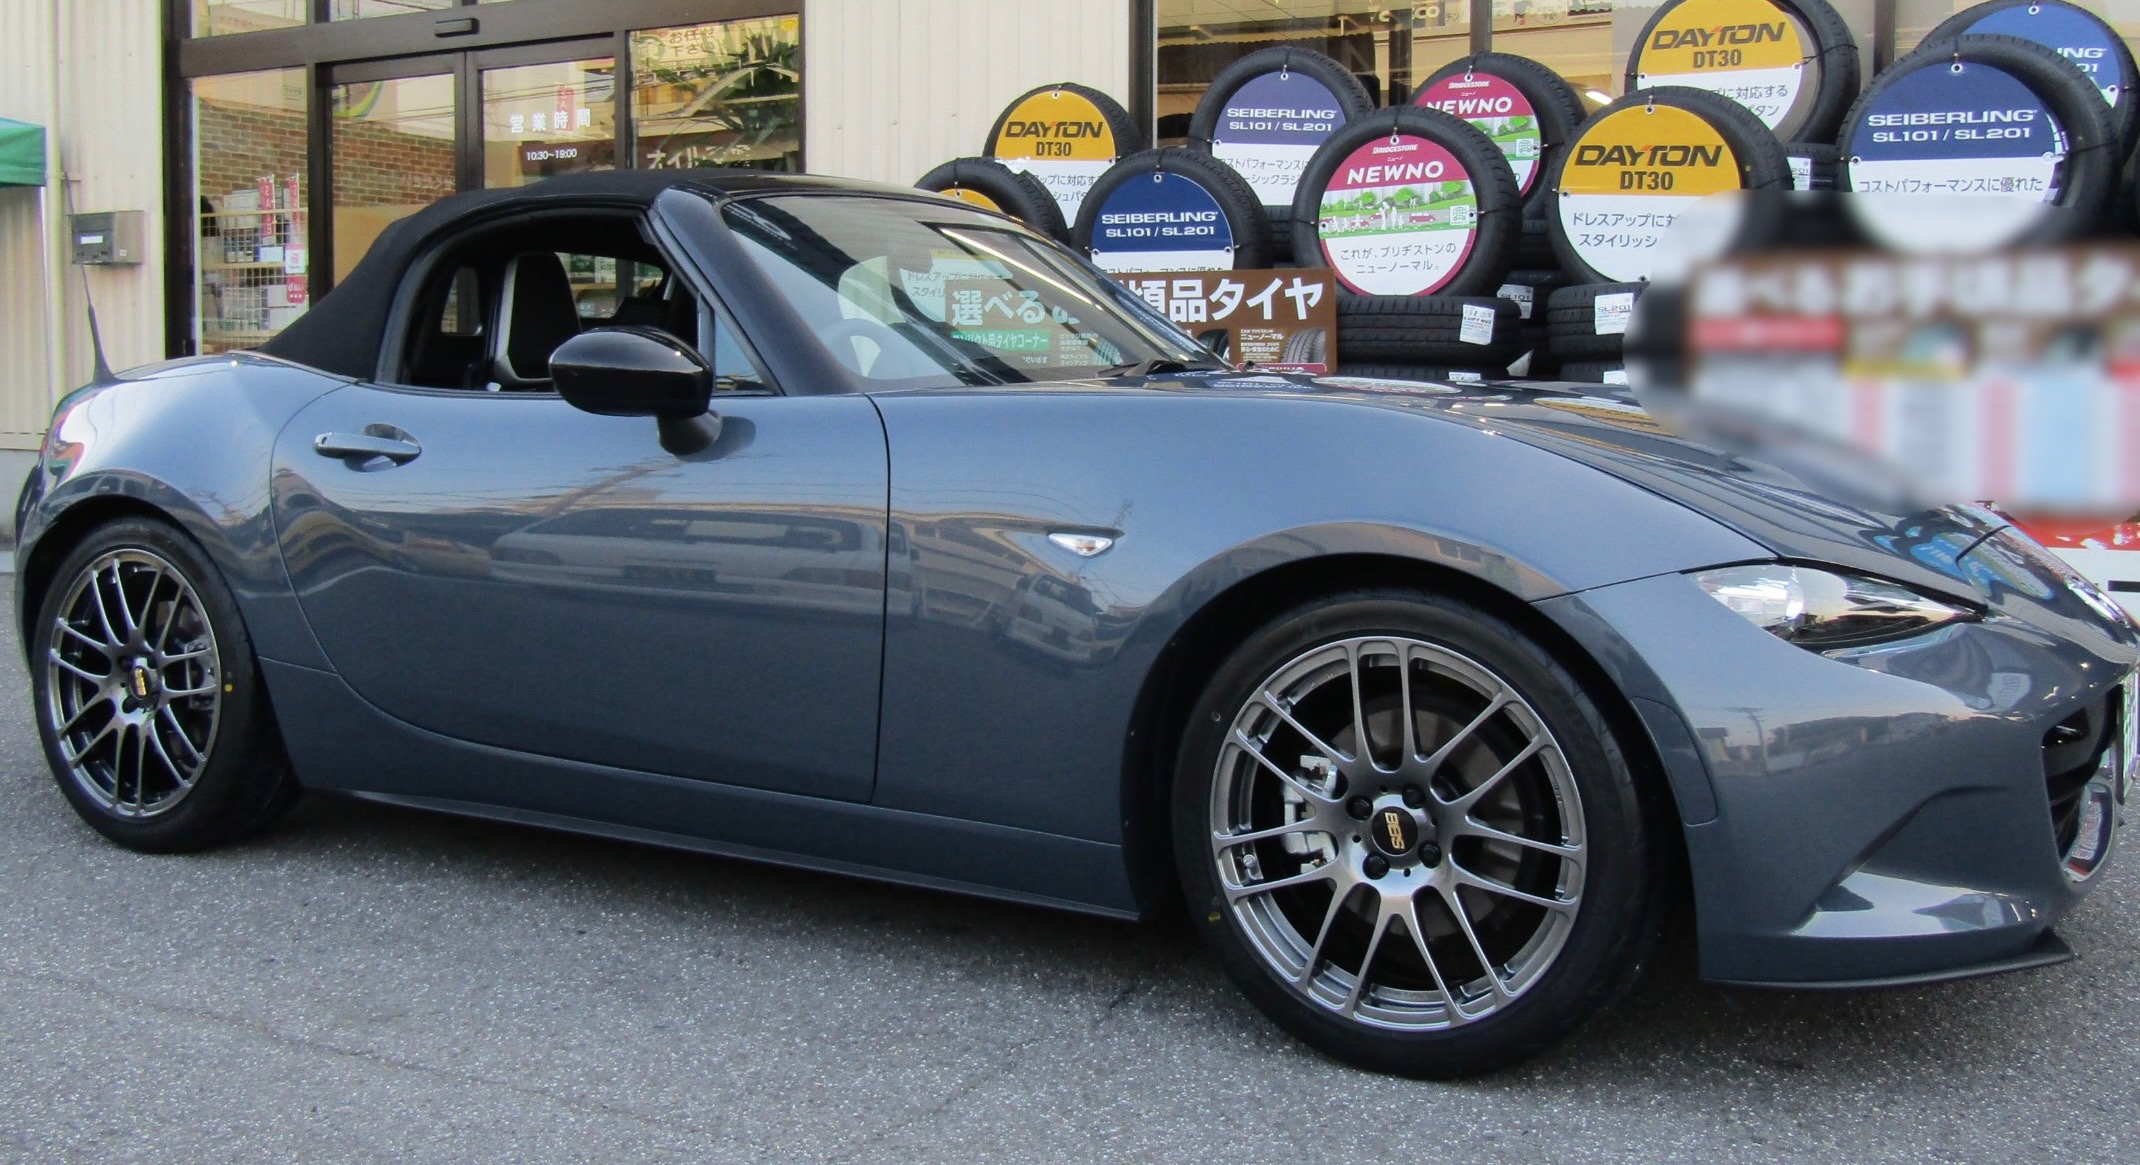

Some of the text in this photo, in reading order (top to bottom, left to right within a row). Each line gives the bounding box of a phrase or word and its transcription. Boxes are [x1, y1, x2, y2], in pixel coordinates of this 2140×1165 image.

[1651, 22, 1785, 50] DAYTON
[1693, 49, 1742, 69] DT30
[2056, 47, 2107, 59] ING
[1448, 80, 1490, 89] BRIDGESTONE
[1227, 108, 1337, 120] SEIBERLING
[1427, 96, 1513, 115] NEWNO
[510, 108, 591, 134] 営業時間
[1229, 121, 1272, 131] SL101
[1282, 123, 1332, 132] SL201
[1868, 109, 2038, 127] SEIBERLING
[1004, 121, 1104, 138] DAYTON
[1873, 130, 1938, 143] SL101
[1954, 128, 2031, 140] SL201
[1035, 141, 1072, 157] DT30
[1371, 144, 1419, 155] BRIDGESTONE
[1575, 145, 1724, 167] DAYTON
[1346, 161, 1445, 185] NEWNO
[1619, 171, 1674, 190] DT30
[1858, 176, 2043, 194] コストパフォーマンスに優れた
[1101, 211, 1218, 225] SEIBERLING
[1105, 228, 1151, 238] SL101
[1161, 226, 1215, 236] SL201
[1384, 812, 1405, 849] BBS
